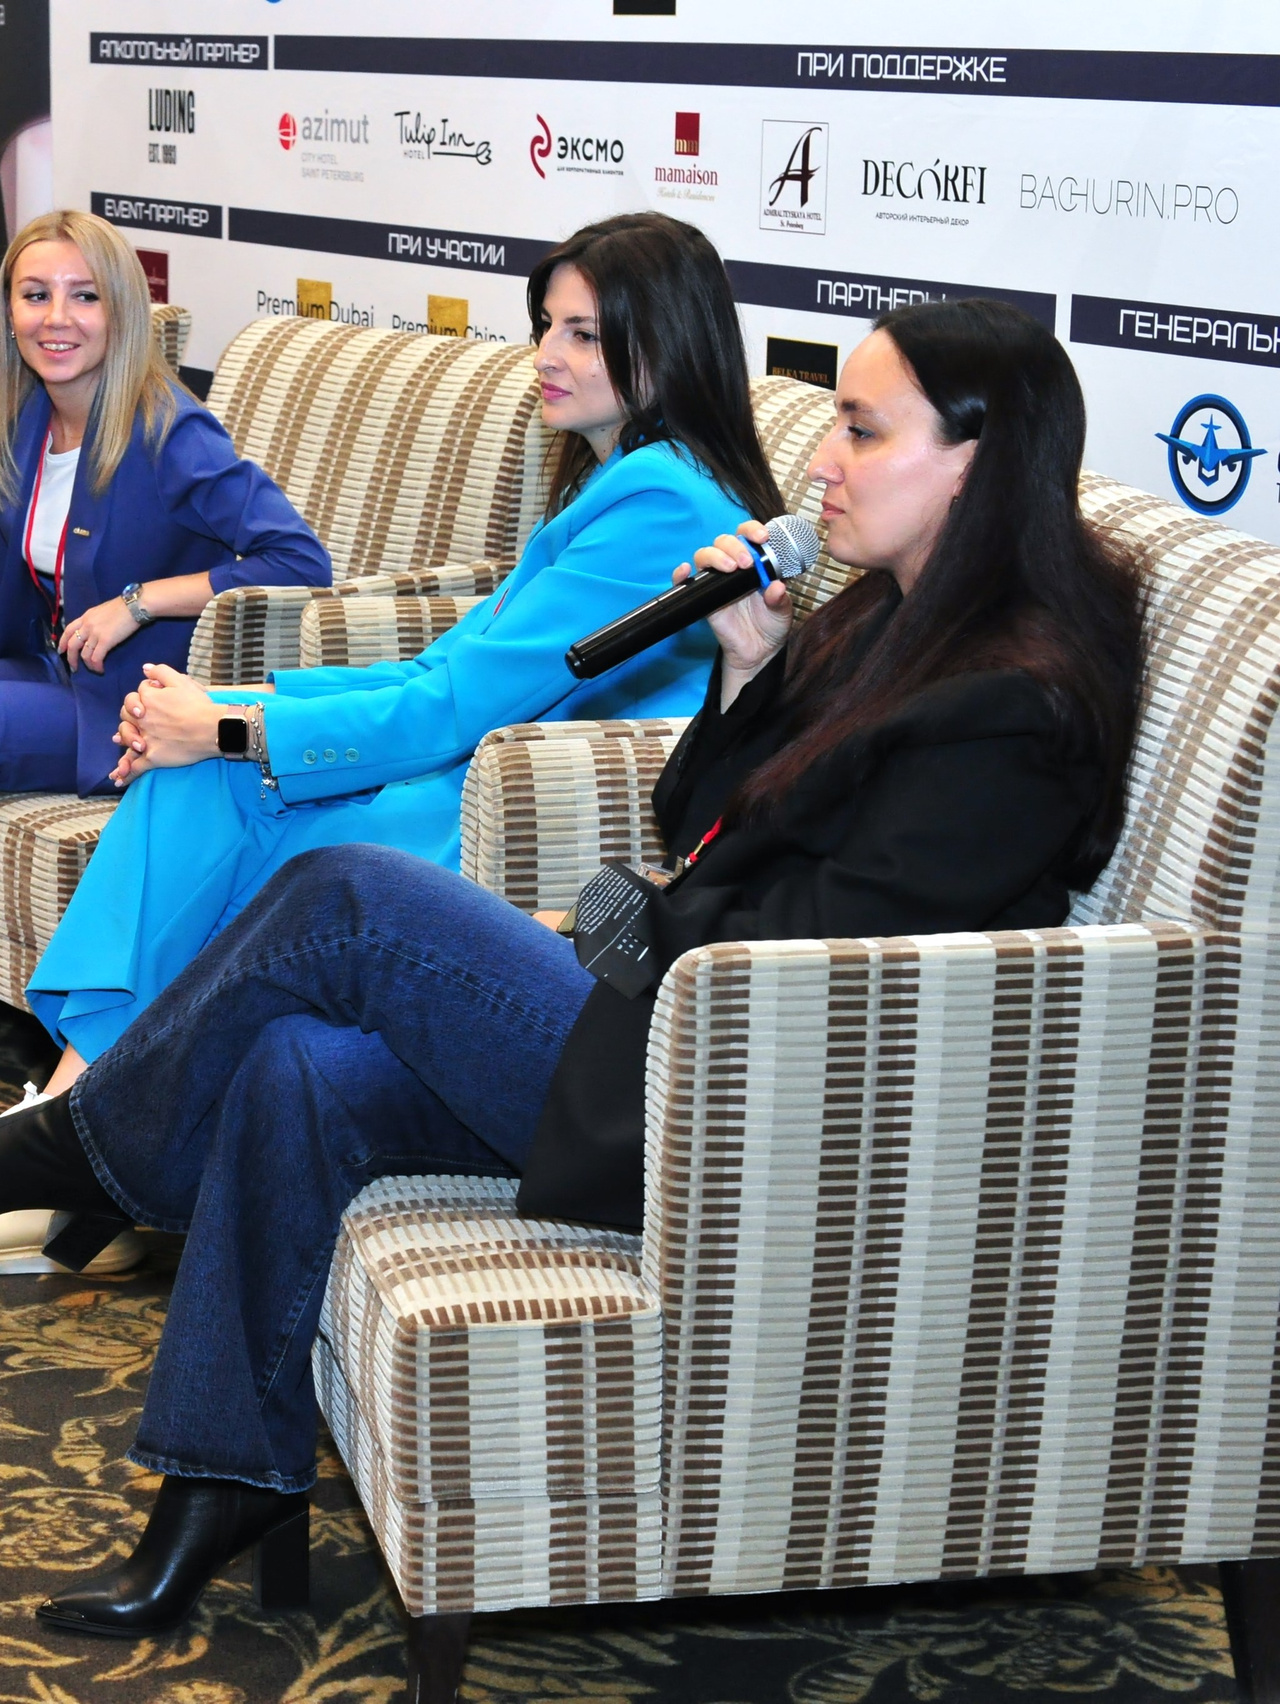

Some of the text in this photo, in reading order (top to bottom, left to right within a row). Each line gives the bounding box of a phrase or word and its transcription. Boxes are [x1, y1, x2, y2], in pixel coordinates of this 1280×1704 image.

[99, 38, 261, 64] АЛКОГОЛЬНЫЙ ПАРТНЕР
[797, 52, 1007, 83] ПРИ ПОДДЕРЖКЕ
[148, 88, 196, 134] LUDING
[302, 108, 369, 144] azimut
[394, 111, 476, 160] Tulip Inn
[557, 136, 624, 163] ЭКСМО
[675, 138, 699, 153] mm
[404, 150, 426, 160] HOTEL
[655, 163, 718, 186] mamaison
[104, 198, 210, 228] EVENT-ПАРТНЕР
[1019, 173, 1240, 225] BACHURIN.PRO
[875, 211, 970, 226] АВТОРСКИЙ ИНТЕРЬЕРНЫЙ ДЕКОР
[388, 232, 506, 267] ПРИ УЧАСТИИ
[256, 290, 374, 328] Premium Dubai
